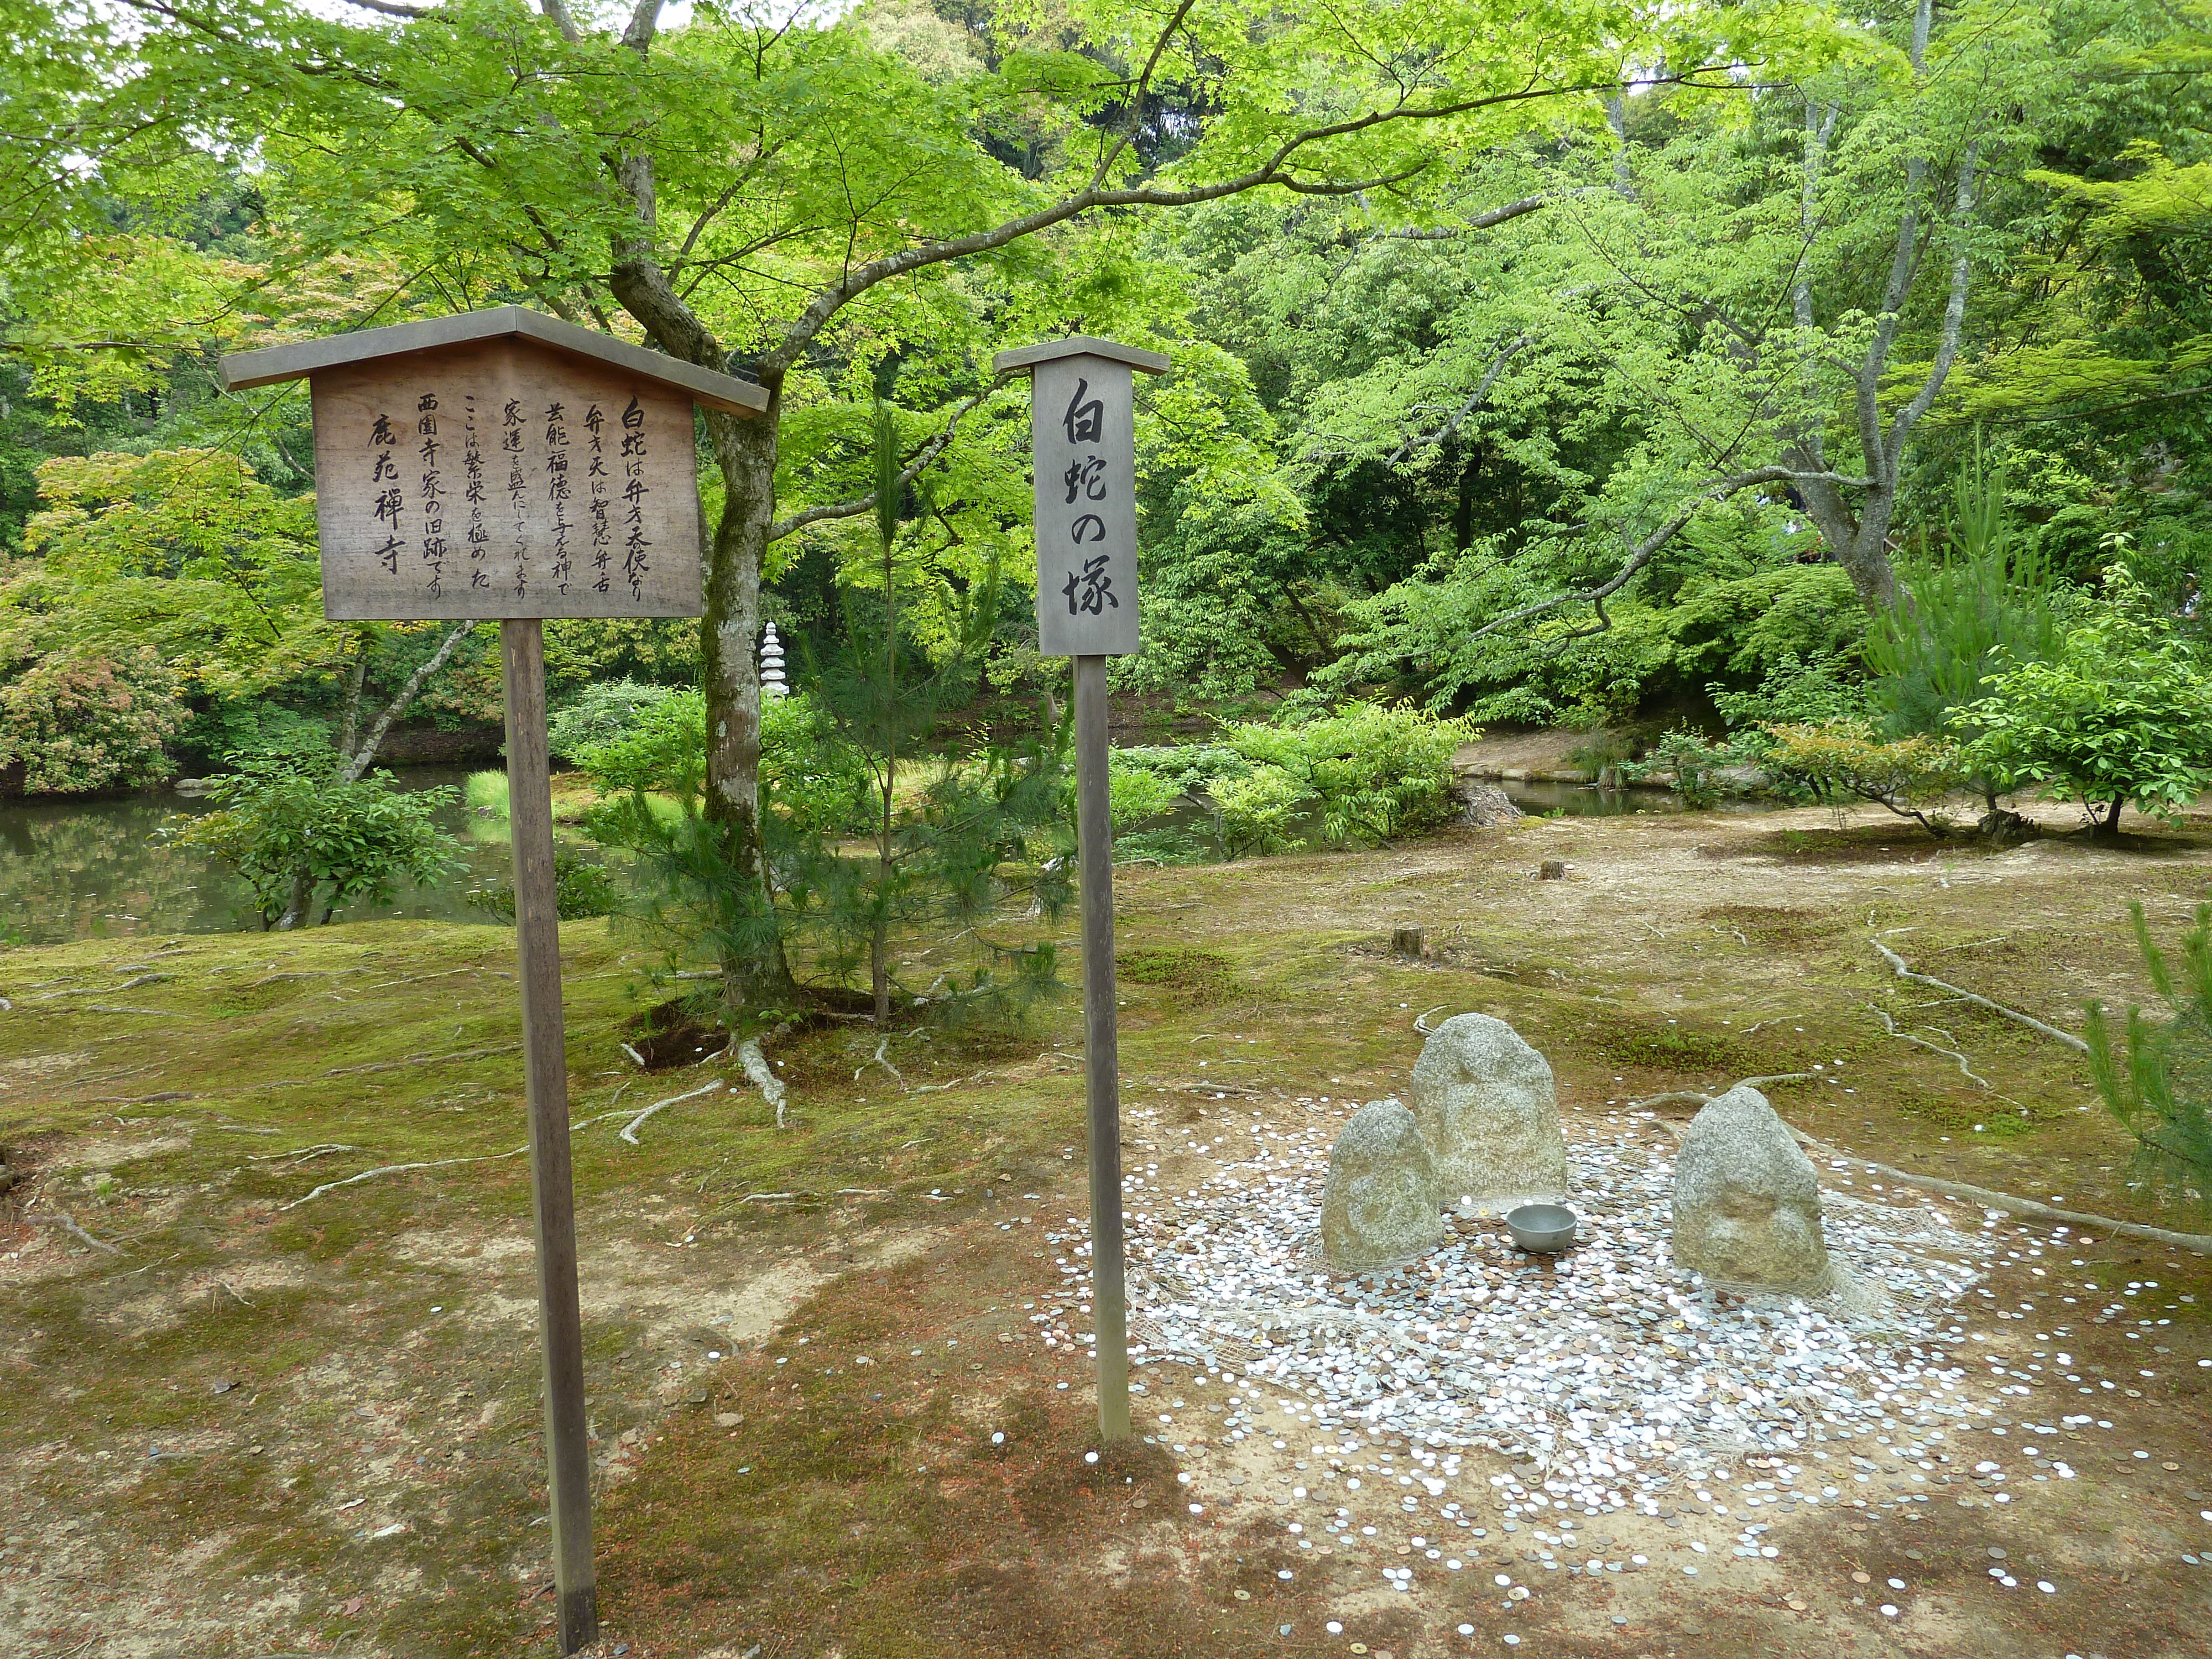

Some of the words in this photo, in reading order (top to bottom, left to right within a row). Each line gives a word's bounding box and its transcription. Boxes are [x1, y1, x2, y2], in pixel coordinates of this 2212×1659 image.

[418, 393, 447, 599] 西園寺家の旧跡です
[462, 395, 490, 589] ここは繁栄を極めた
[1062, 378, 1119, 615] 白蛇の塚
